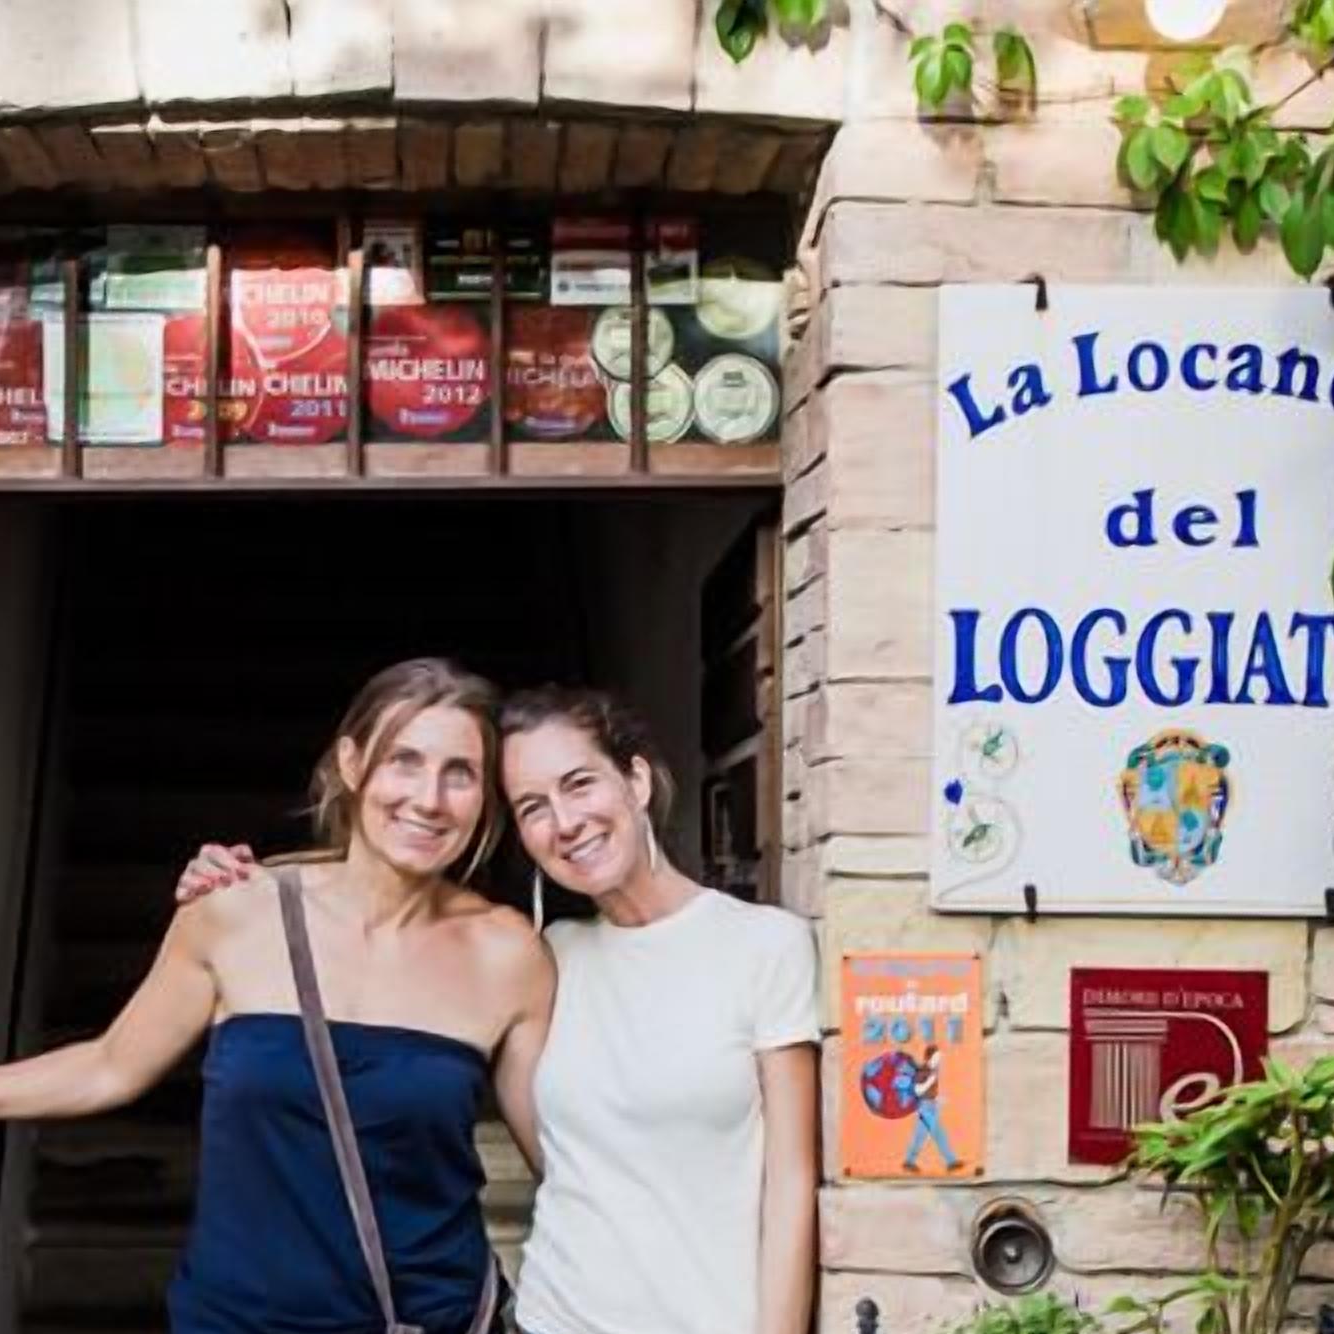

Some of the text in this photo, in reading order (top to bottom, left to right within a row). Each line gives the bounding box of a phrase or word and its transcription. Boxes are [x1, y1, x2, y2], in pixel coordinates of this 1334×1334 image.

[948, 362, 1053, 439] La
[1105, 488, 1261, 548] del
[854, 992, 969, 1017] routard
